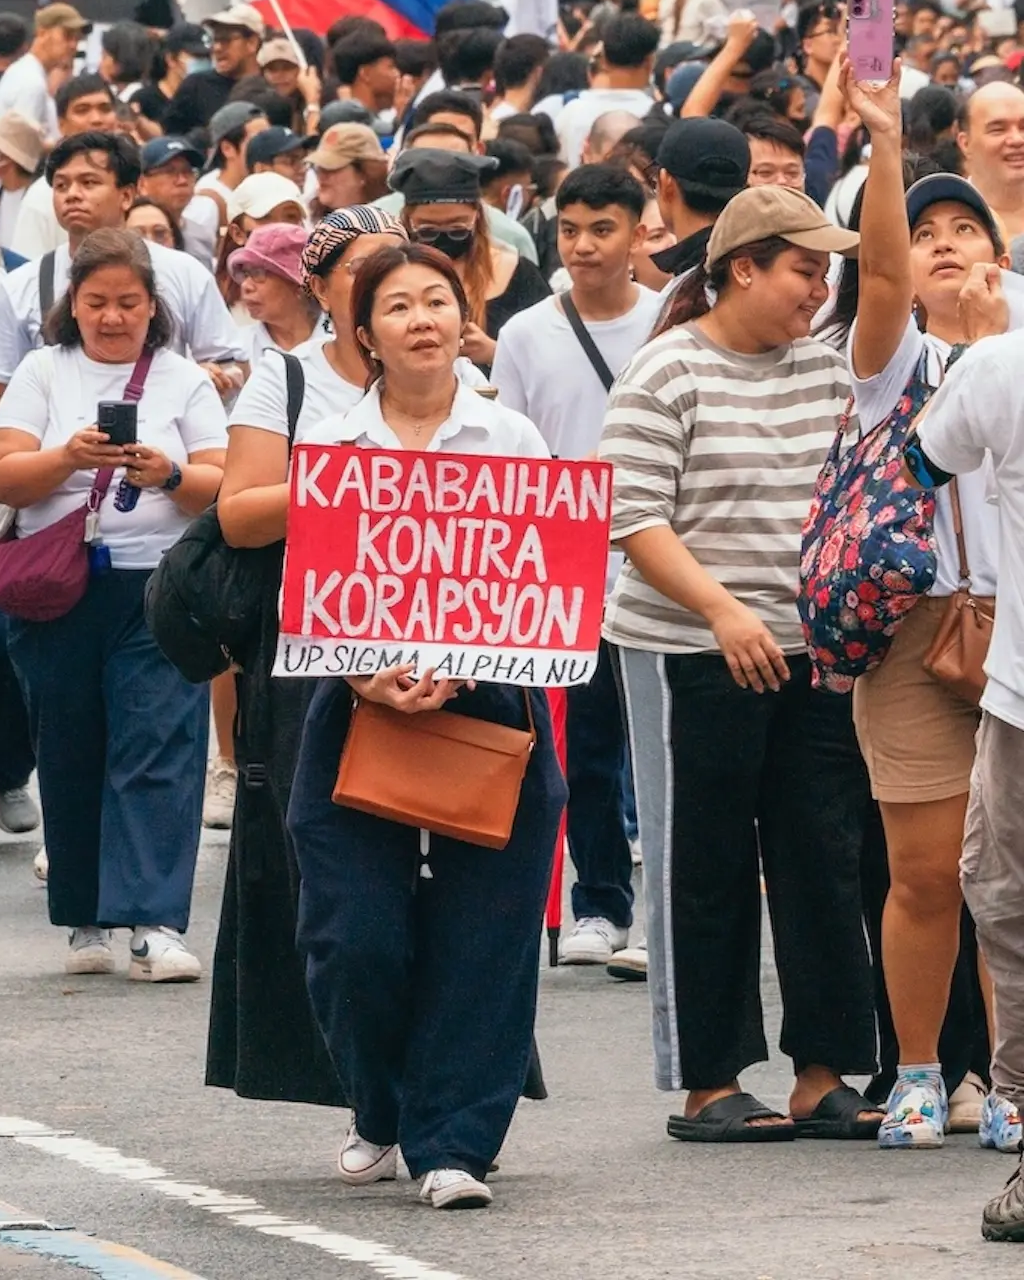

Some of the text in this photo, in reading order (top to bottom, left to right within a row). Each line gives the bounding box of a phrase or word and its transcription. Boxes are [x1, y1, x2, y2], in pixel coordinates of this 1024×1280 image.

[295, 450, 609, 521] KABABAIHAN
[355, 512, 548, 583] KONTRA
[300, 569, 585, 647] KORAPSYON
[283, 643, 590, 684] UP SIGMA ALPHA NU
